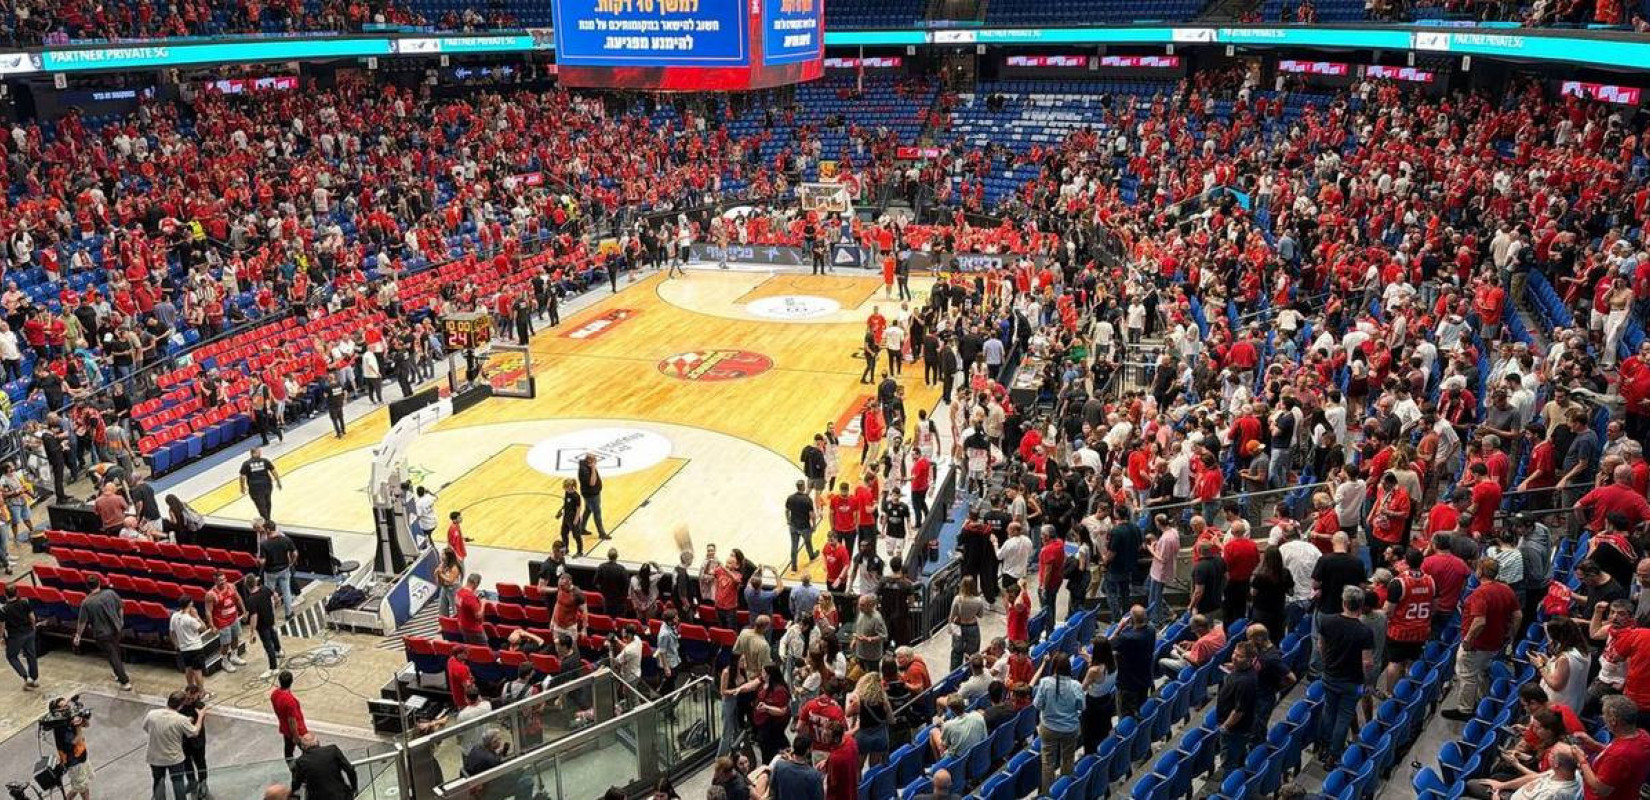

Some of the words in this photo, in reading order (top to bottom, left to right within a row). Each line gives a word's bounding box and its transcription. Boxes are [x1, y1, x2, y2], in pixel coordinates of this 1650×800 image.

[695, 20, 719, 31] חשוב
[651, 34, 694, 50] להימנע
[51, 50, 104, 62] PARTNER
[107, 47, 152, 60] PRIVATE
[449, 331, 467, 345] 24
[1405, 603, 1431, 619] 26
